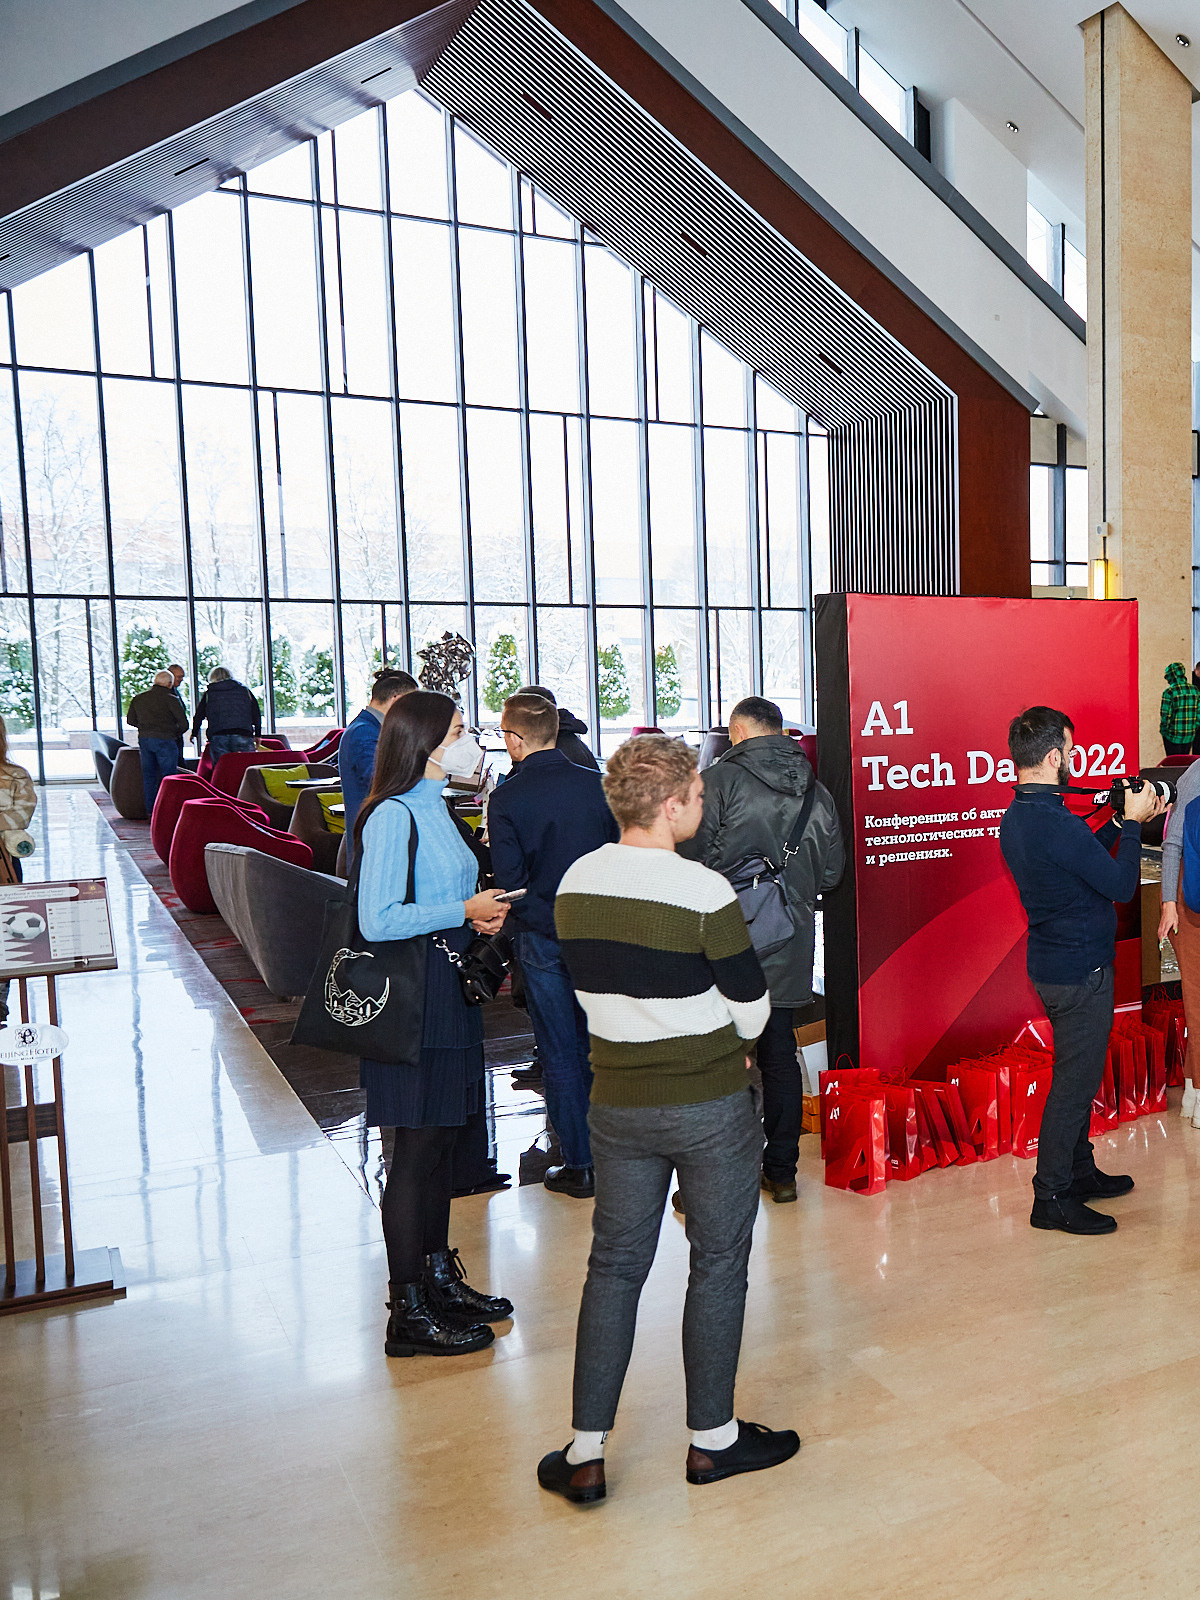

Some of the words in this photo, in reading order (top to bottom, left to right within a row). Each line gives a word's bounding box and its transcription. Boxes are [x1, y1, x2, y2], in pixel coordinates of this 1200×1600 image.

[861, 700, 913, 736] A1
[862, 753, 956, 791] Tech
[967, 750, 1018, 785] Da
[1069, 743, 1126, 778] 022
[864, 812, 959, 830] Конференция
[961, 807, 977, 821] об
[865, 826, 985, 847] технологических
[987, 826, 1001, 838] тр
[865, 854, 876, 865] и
[878, 848, 953, 867] решениях.
[0, 1051, 29, 1060] EIJING
[29, 1047, 59, 1057] HOTEL
[1027, 1081, 1037, 1097] A1
